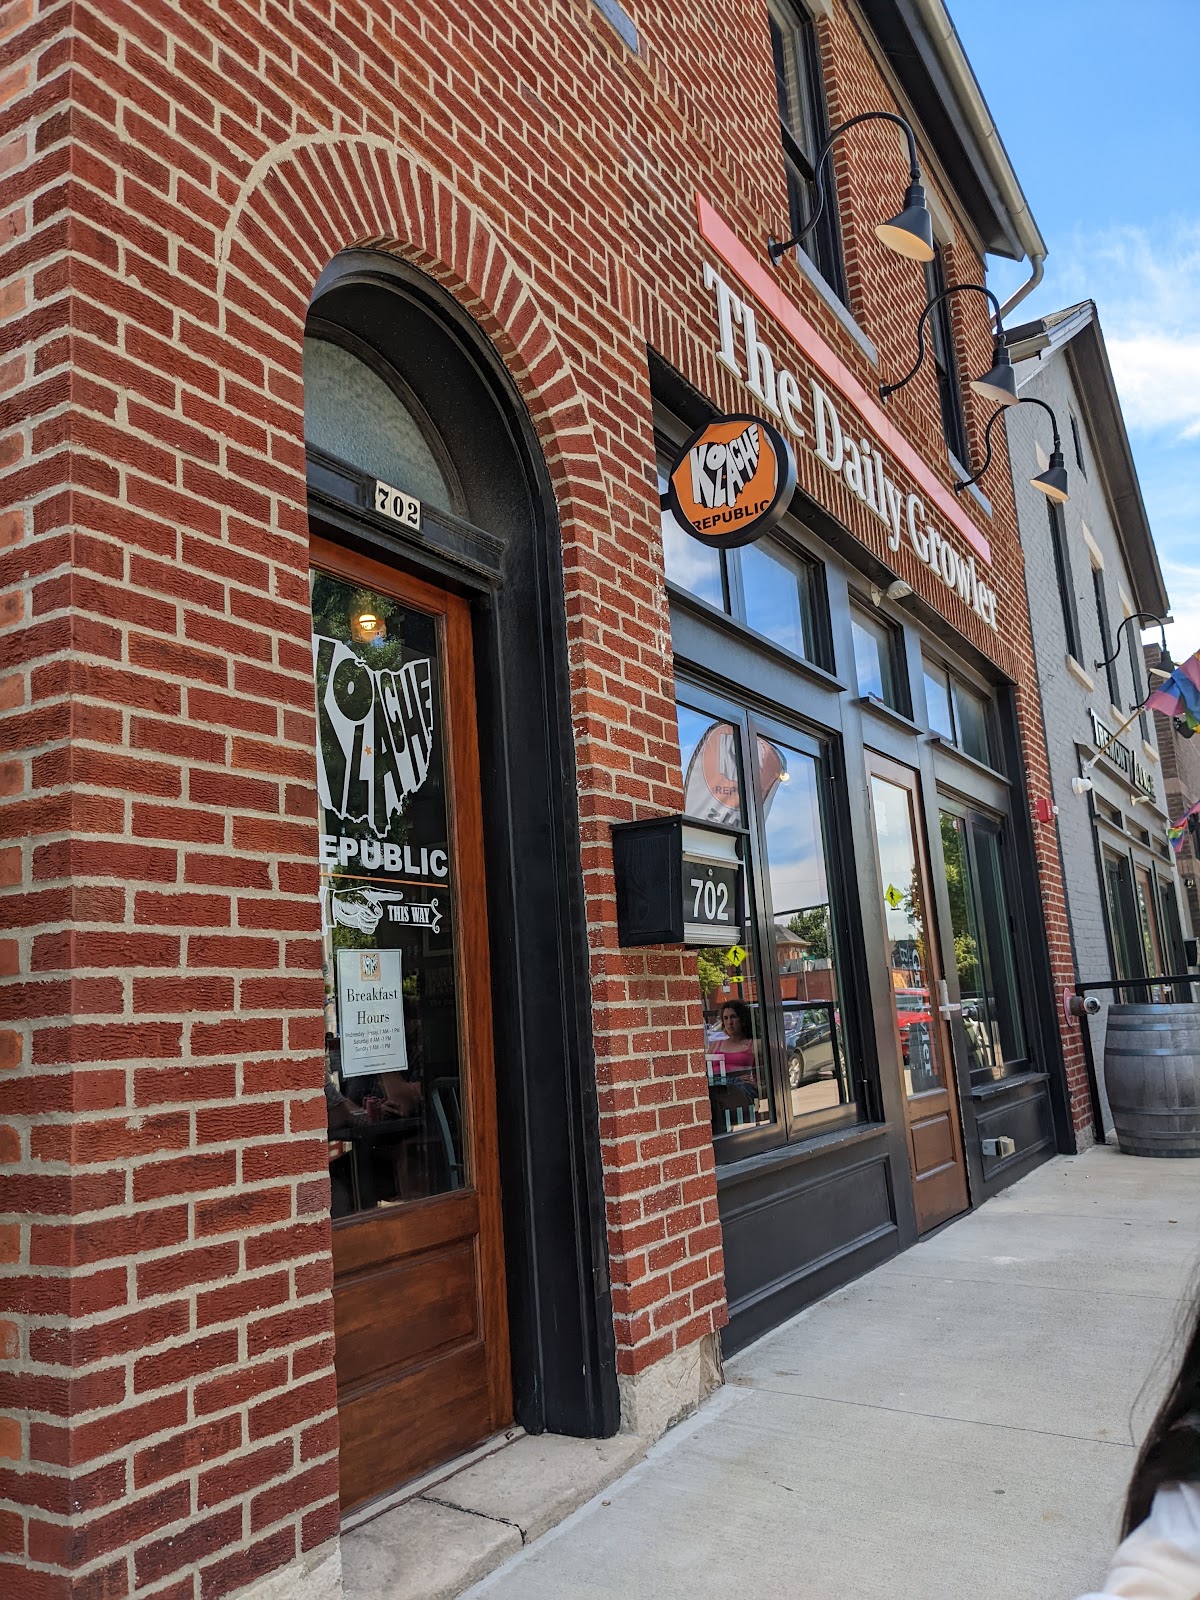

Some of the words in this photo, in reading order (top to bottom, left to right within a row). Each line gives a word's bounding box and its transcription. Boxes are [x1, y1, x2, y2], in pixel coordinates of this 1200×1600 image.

[689, 423, 760, 509] KOLACHE
[703, 262, 805, 439] The
[808, 377, 902, 553] Daily
[905, 493, 999, 632] Growler
[378, 487, 418, 525] 702
[691, 500, 769, 531] REPUBLIC
[318, 833, 448, 877] EPUBLIC
[387, 904, 409, 923] THIS
[410, 906, 430, 923] WAY
[690, 878, 729, 921] 702
[347, 987, 398, 1002] Breakfast
[357, 1010, 390, 1025] Hours
